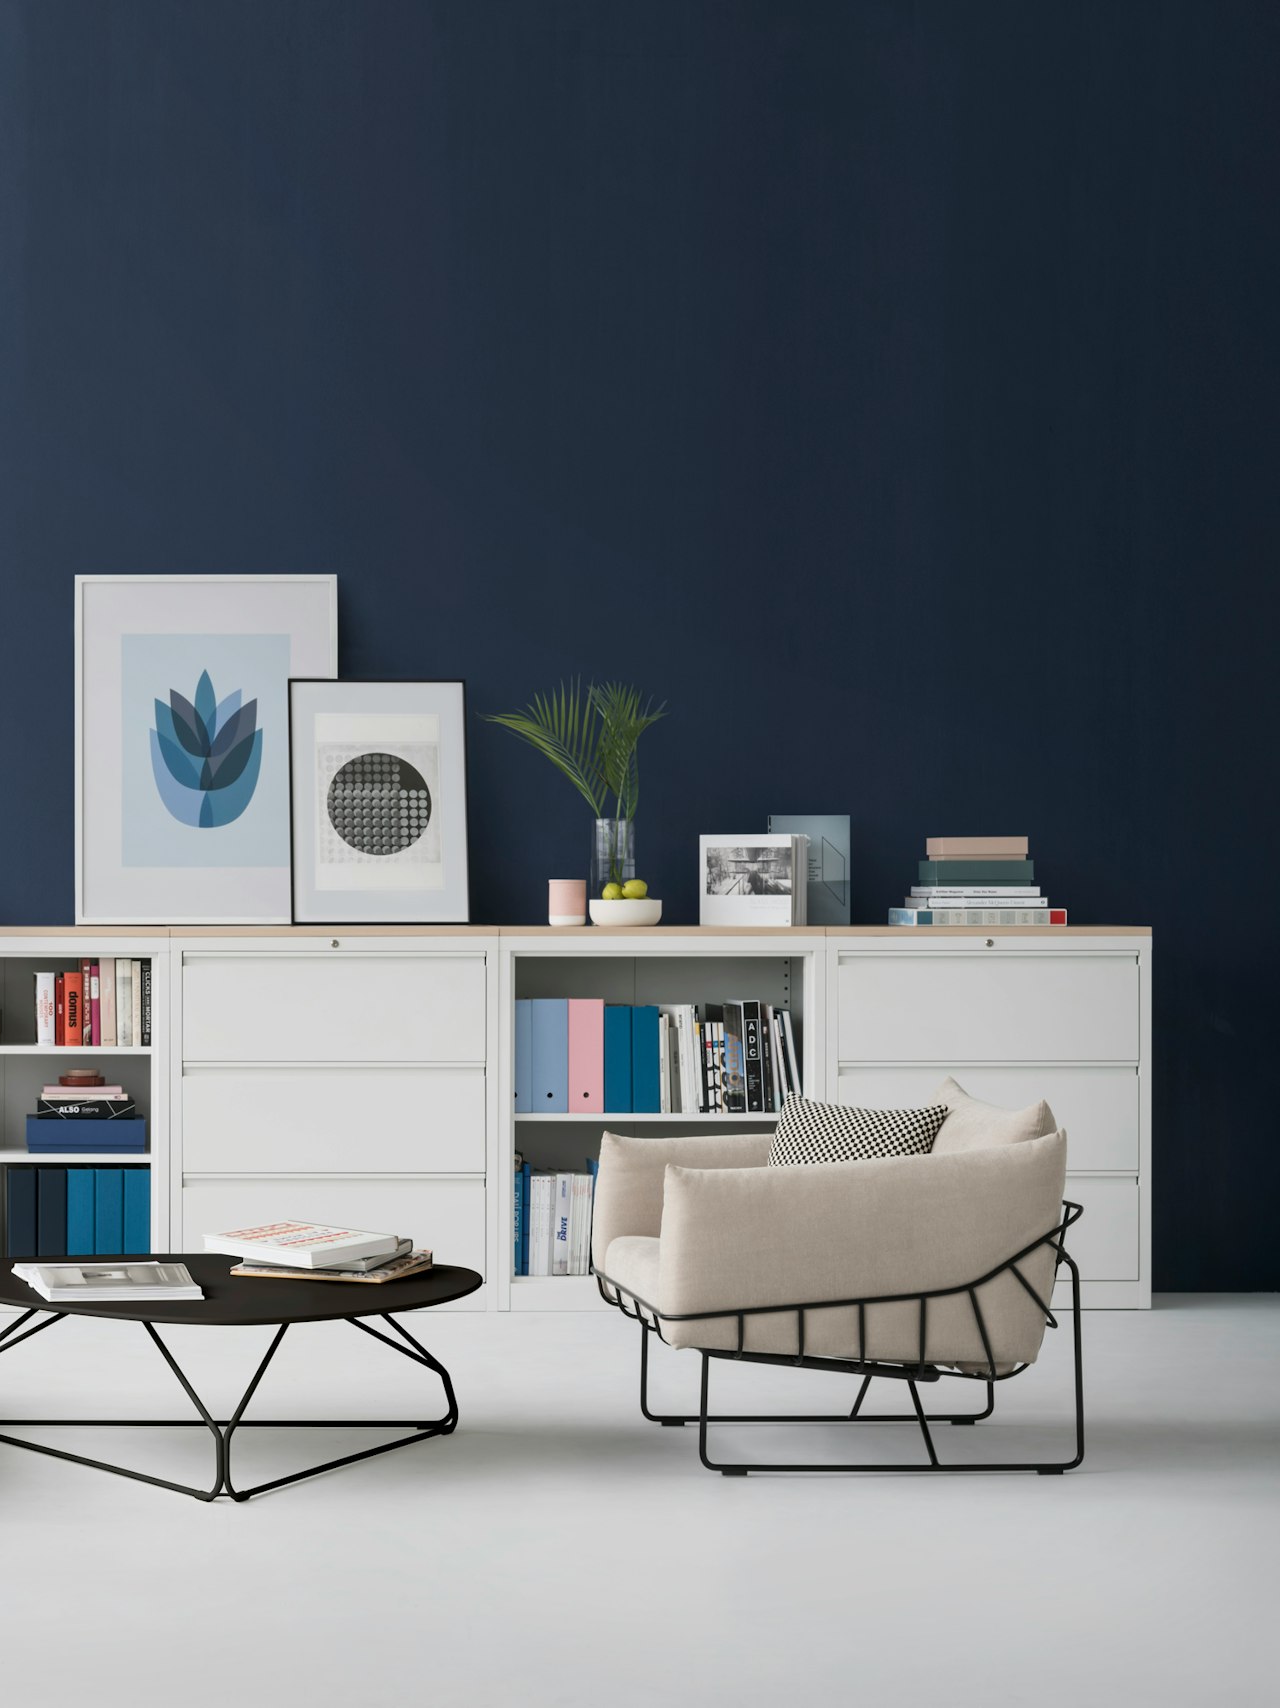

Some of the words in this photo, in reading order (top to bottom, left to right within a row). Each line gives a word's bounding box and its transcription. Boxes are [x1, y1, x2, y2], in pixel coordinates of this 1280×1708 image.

[68, 991, 78, 1028] domus
[727, 1033, 740, 1086] ANDO
[560, 1216, 568, 1241] DRIVE
